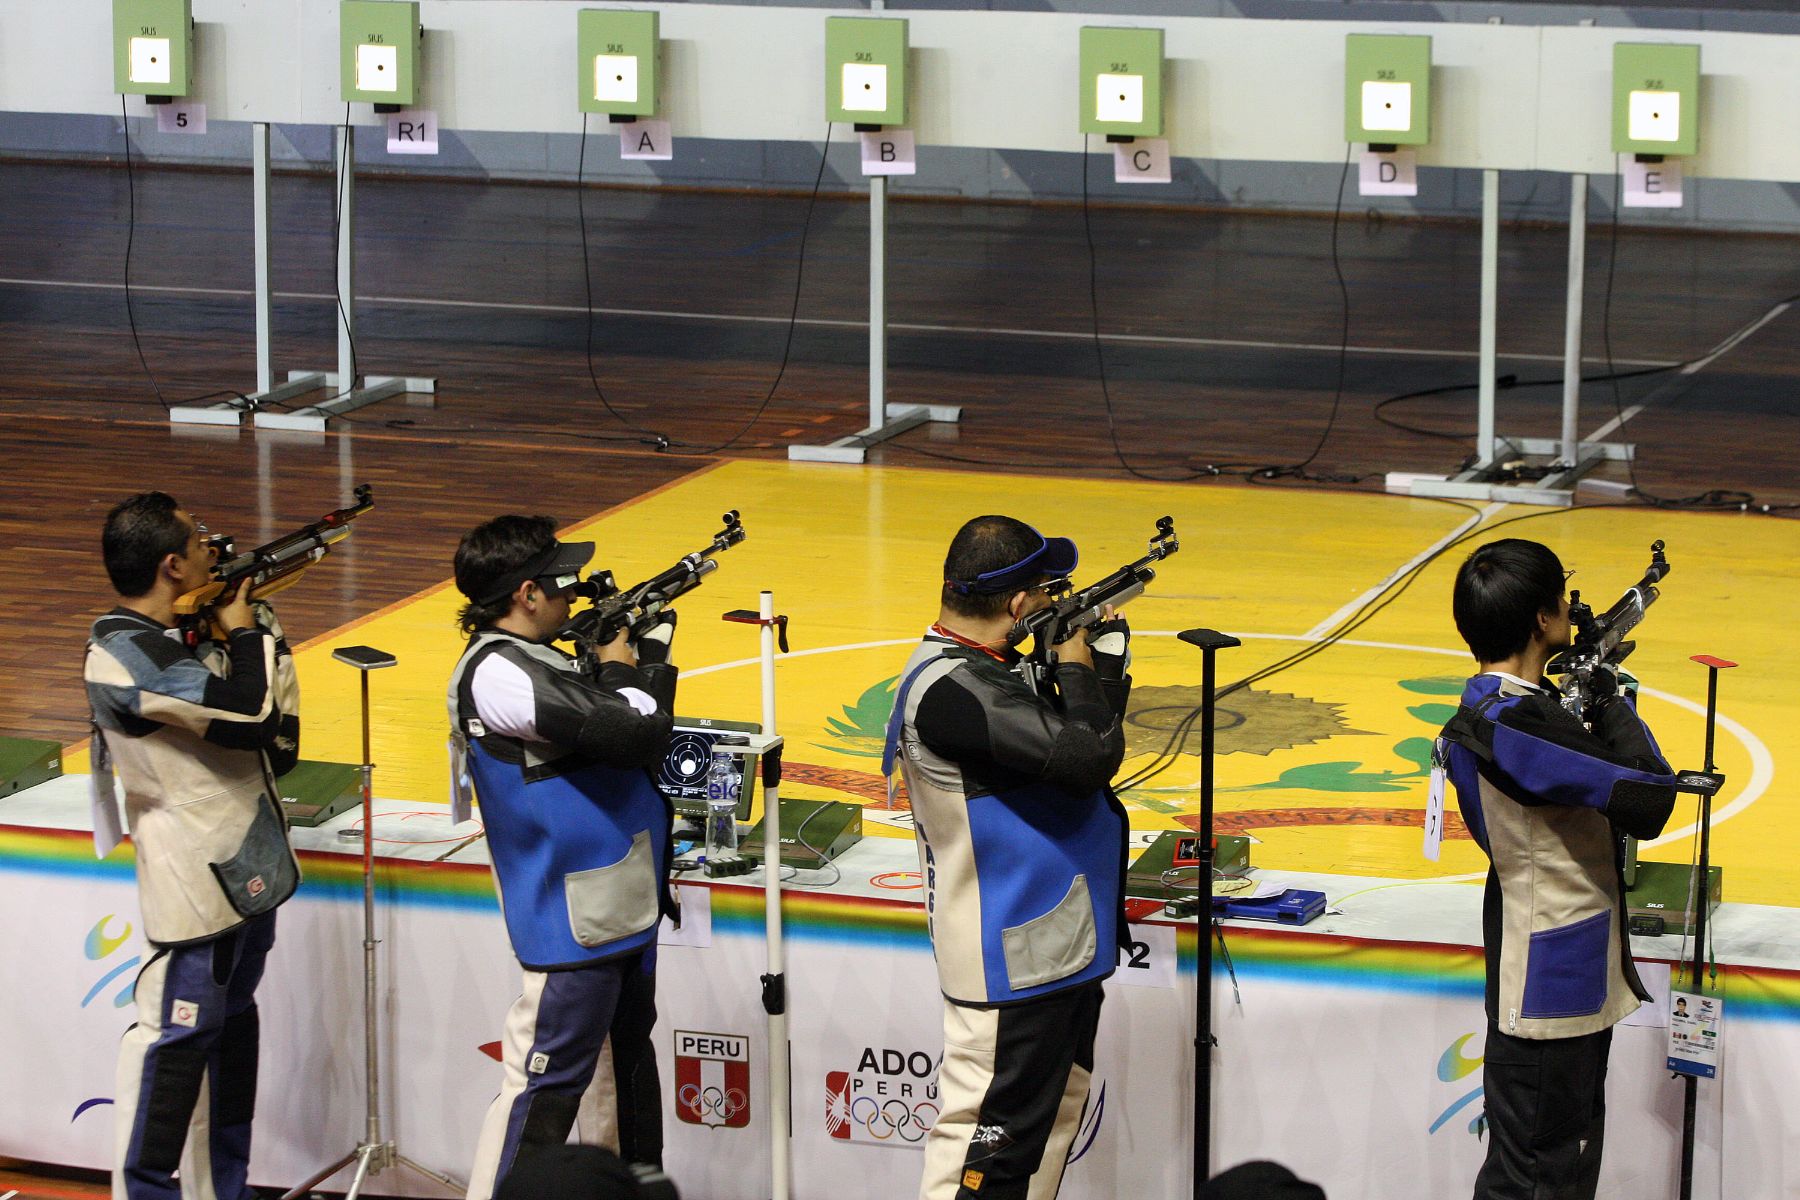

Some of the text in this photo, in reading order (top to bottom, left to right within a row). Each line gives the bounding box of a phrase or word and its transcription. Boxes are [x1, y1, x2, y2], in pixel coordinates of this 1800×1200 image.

[176, 112, 188, 128] 5
[398, 122, 425, 142] R1
[638, 131, 655, 152] A
[881, 142, 896, 162] B
[1134, 150, 1151, 171] C
[1380, 162, 1397, 183] D
[1646, 172, 1662, 193] E
[682, 1037, 741, 1058] PERU
[857, 1047, 933, 1078] ADO
[853, 1078, 938, 1100] PERÚ
